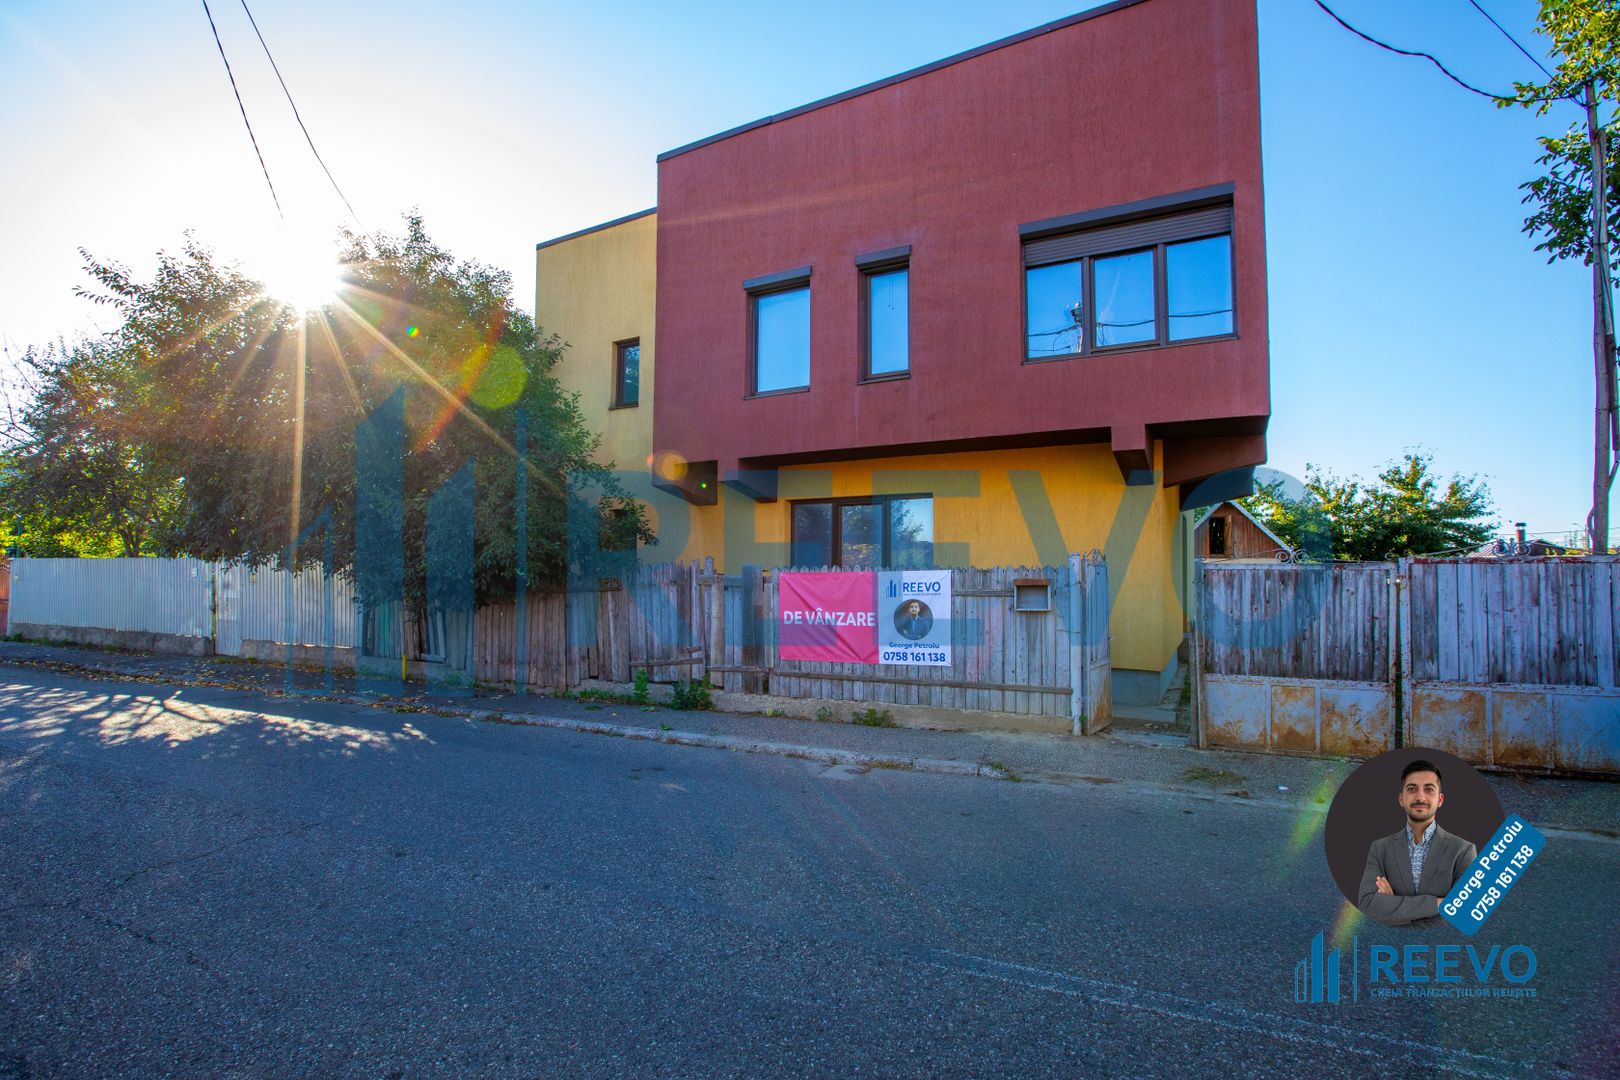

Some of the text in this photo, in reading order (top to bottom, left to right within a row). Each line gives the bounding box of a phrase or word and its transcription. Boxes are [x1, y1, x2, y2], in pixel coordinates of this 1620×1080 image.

[902, 581, 941, 593] REEVO
[783, 607, 876, 627] DE VÂNZARE
[888, 641, 913, 650] George
[883, 651, 946, 662] 0758 161 138
